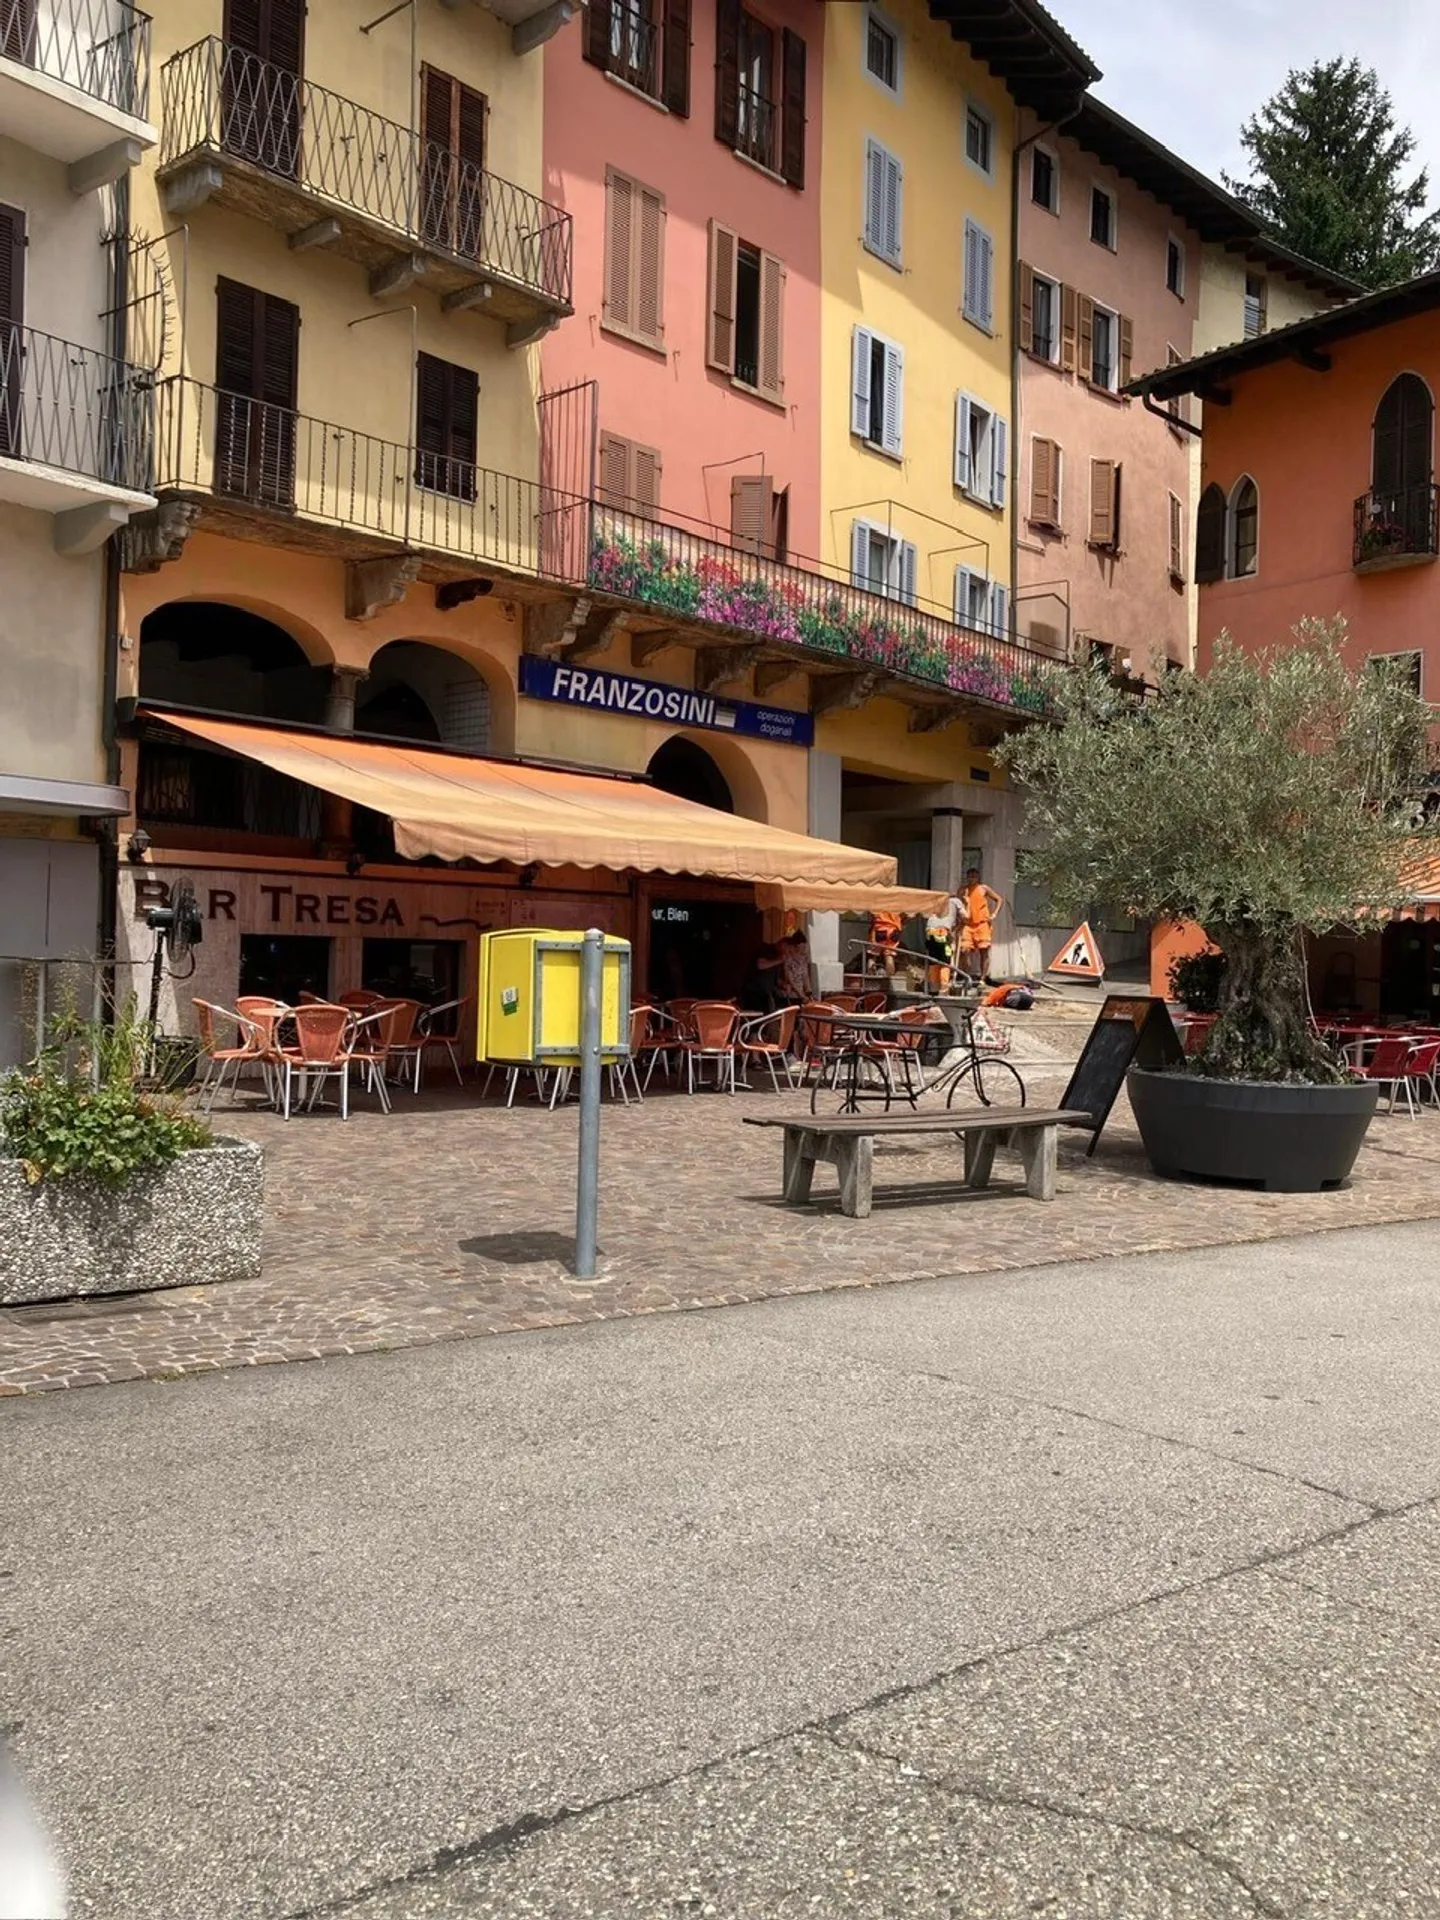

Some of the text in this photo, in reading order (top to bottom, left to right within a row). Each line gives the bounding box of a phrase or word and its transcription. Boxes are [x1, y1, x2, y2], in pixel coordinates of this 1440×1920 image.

[552, 667, 715, 725] FRANZOSINI
[756, 710, 795, 725] operazioni
[760, 723, 792, 737] doganali
[134, 879, 404, 926] BR TRESA
